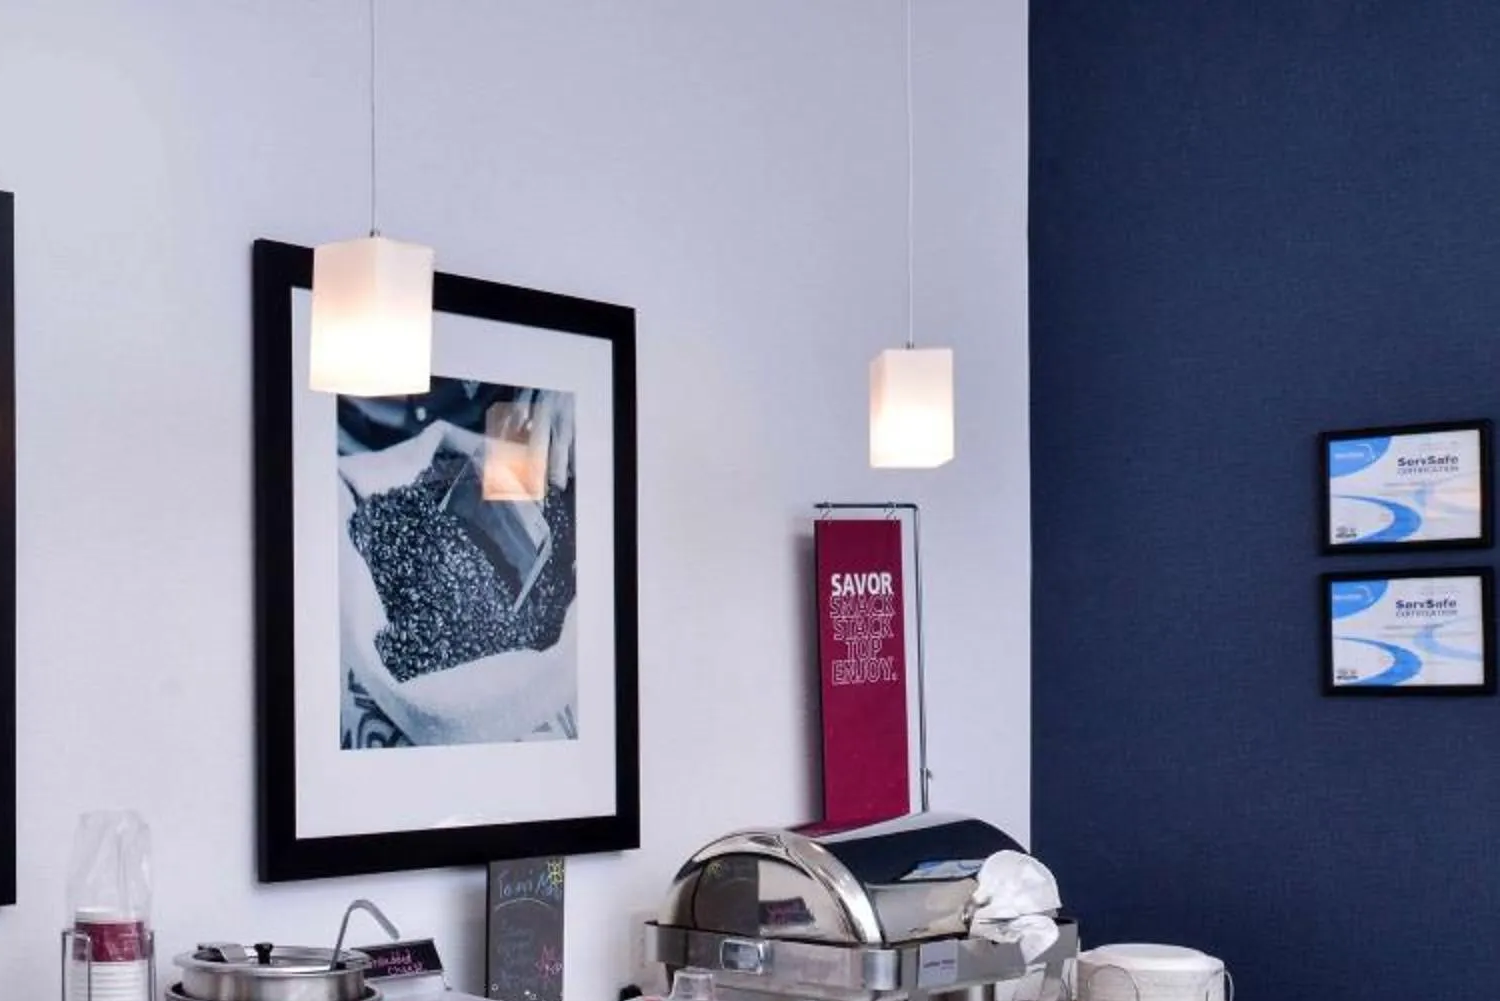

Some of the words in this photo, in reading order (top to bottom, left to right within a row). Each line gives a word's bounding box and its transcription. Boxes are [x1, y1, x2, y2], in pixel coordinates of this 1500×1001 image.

[1397, 455, 1459, 467] ServSafe
[831, 572, 893, 596] SAVOR
[1395, 597, 1457, 610] ServSafe
[833, 615, 895, 640] STACK
[845, 637, 882, 661] TOP
